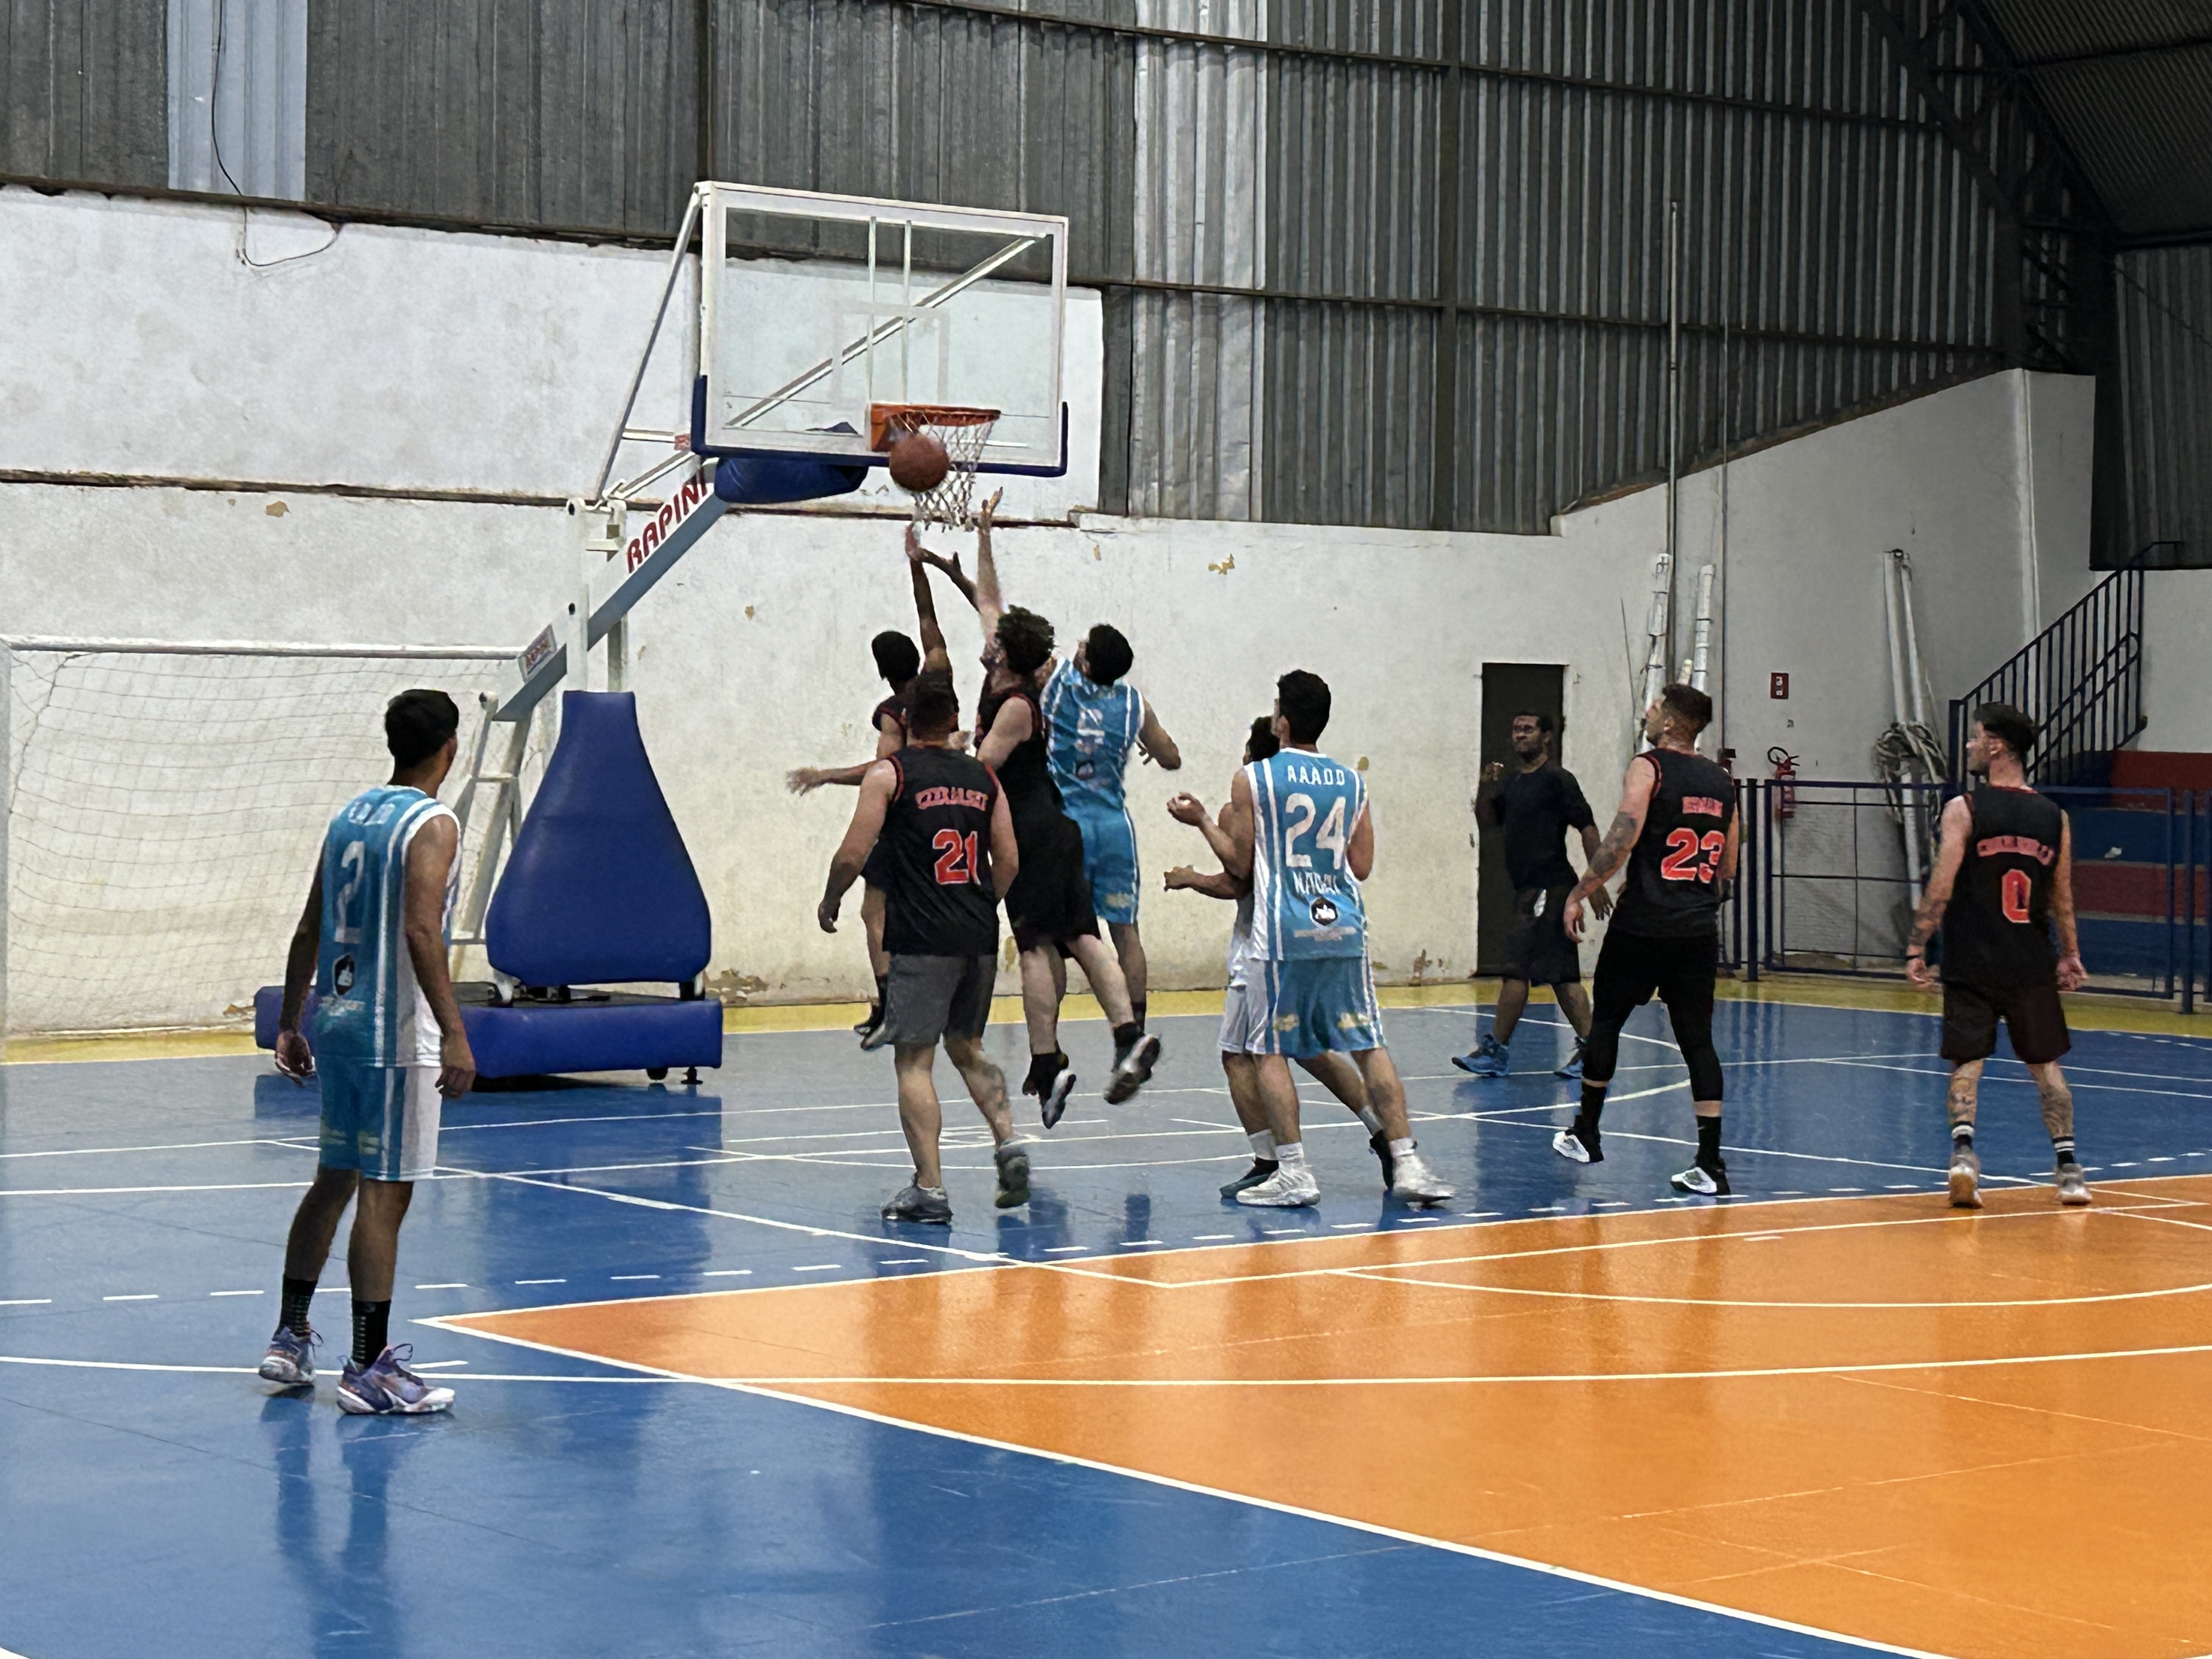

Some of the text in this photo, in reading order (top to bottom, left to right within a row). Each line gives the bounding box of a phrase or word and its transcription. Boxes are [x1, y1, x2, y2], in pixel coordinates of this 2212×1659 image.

[627, 466, 707, 573] RAPINI
[932, 828, 981, 886] 21
[1286, 793, 1346, 870] 24
[1661, 827, 1725, 884] 23
[335, 840, 365, 944] 2
